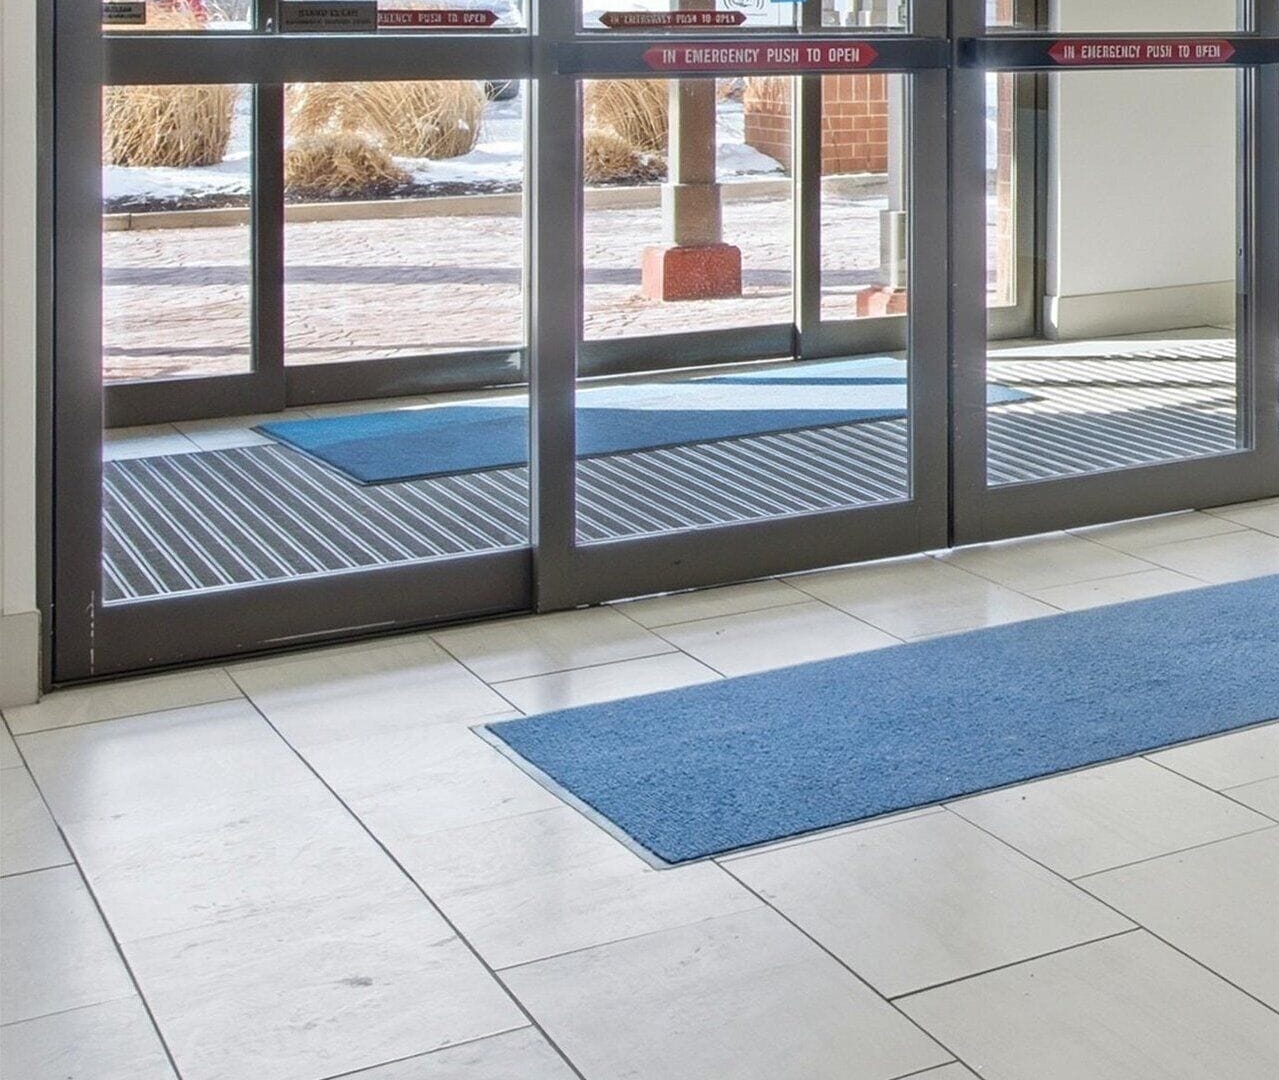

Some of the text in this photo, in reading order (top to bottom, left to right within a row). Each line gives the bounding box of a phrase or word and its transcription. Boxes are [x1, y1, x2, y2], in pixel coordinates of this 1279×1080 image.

[663, 47, 860, 63] IN EMERGENCY PUSH TO OPEN
[1064, 45, 1221, 59] IN EMERGENCY PUSH TO OPEN
